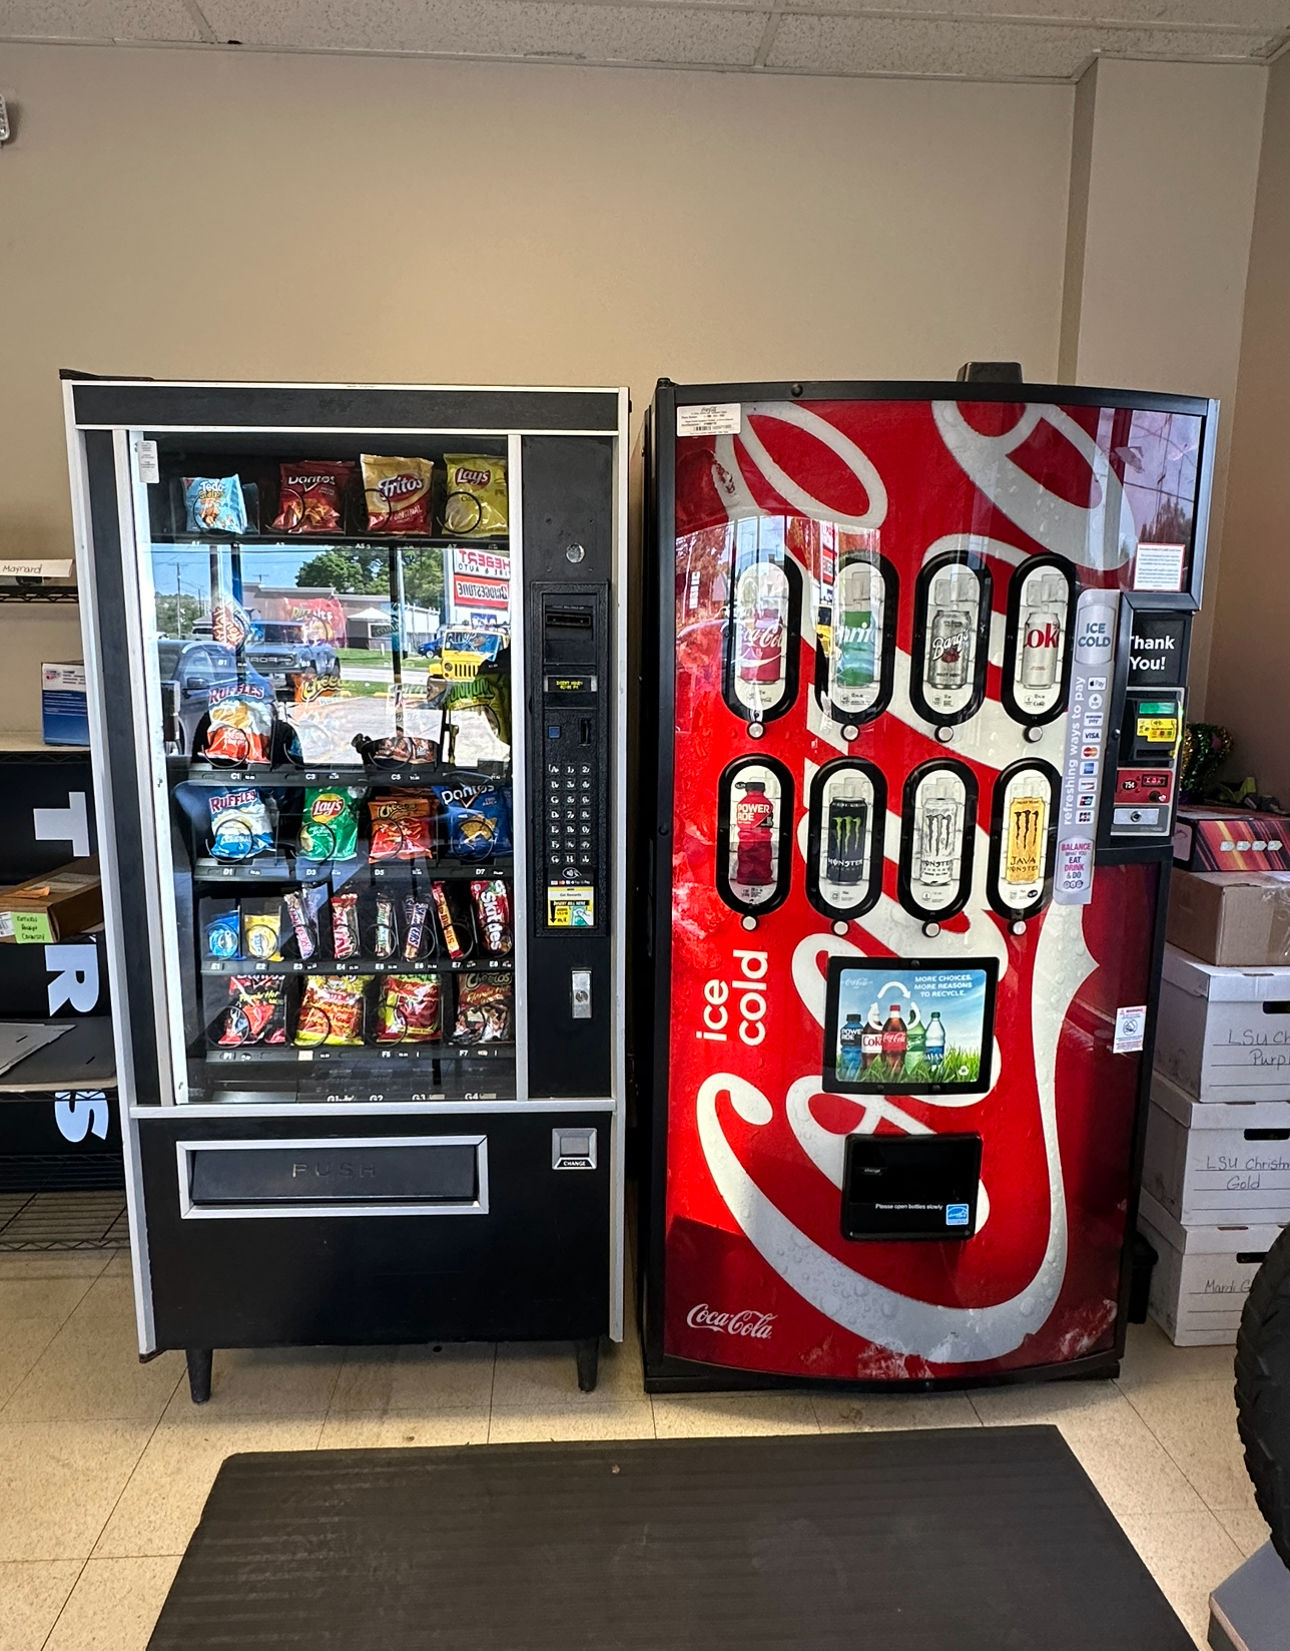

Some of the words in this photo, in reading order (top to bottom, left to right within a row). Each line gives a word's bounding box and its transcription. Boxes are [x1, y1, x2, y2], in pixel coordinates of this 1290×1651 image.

[378, 475, 423, 501] Fritos
[3, 563, 42, 574] Maynard
[1086, 622, 1106, 634] ICE
[1078, 636, 1111, 648] COLD
[1130, 656, 1166, 670] You!
[1075, 676, 1086, 701] pay
[1072, 703, 1081, 716] to
[1070, 721, 1081, 755] ways
[1064, 759, 1079, 824] refreshing
[209, 789, 257, 814] RUFFLES
[313, 800, 344, 816] Lay's
[737, 804, 770, 813] POWER
[737, 813, 754, 821] ADE
[1061, 842, 1091, 851] BALANCE
[1010, 856, 1035, 865] JAVA
[1064, 863, 1085, 871] DRINK
[732, 949, 768, 1046] cold
[696, 979, 729, 1041] ice
[1229, 1029, 1267, 1045] LSU
[293, 1163, 376, 1178] PUSH
[1207, 1156, 1238, 1170] LSU
[1227, 1175, 1260, 1190] Gold
[687, 1303, 778, 1339] Coca-Cola
